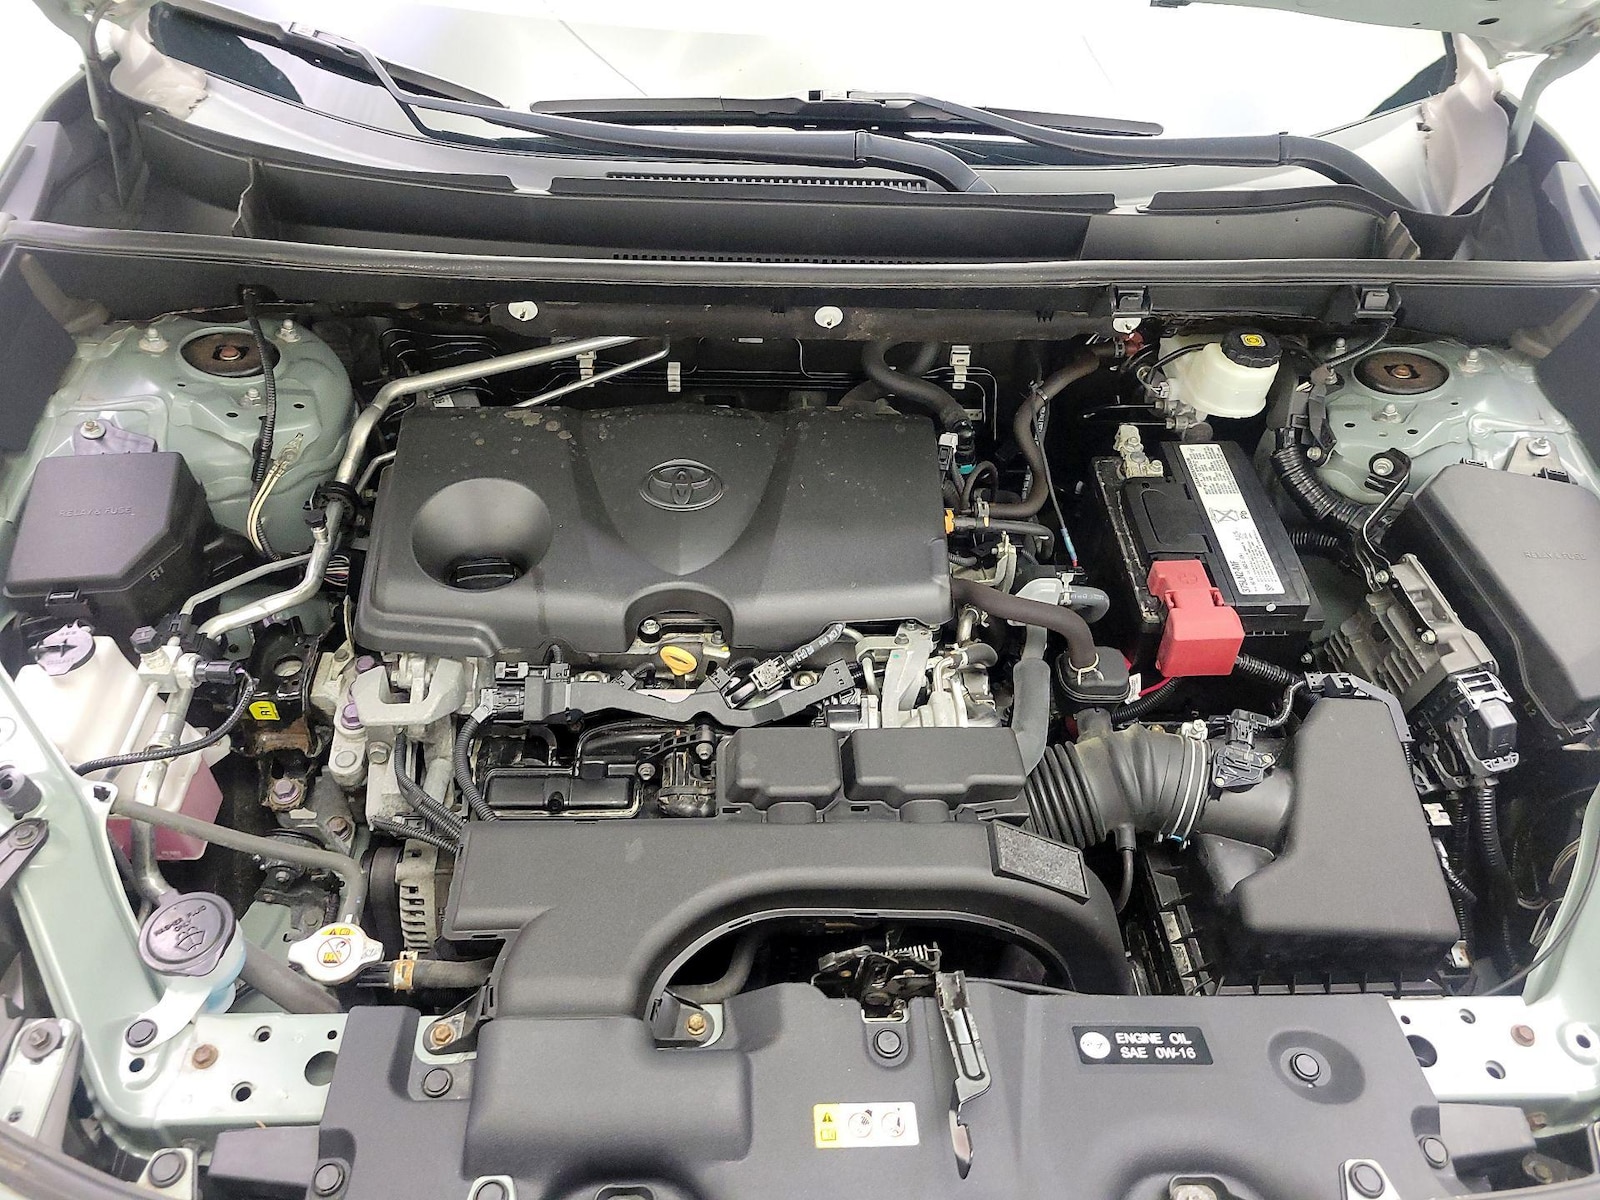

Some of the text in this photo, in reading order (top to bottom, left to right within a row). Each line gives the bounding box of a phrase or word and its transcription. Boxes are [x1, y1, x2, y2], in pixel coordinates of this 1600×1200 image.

[104, 505, 136, 516] FUSE
[1114, 1032, 1193, 1045] ENGINE OIL
[1120, 1046, 1197, 1059] SAE 0W-16
